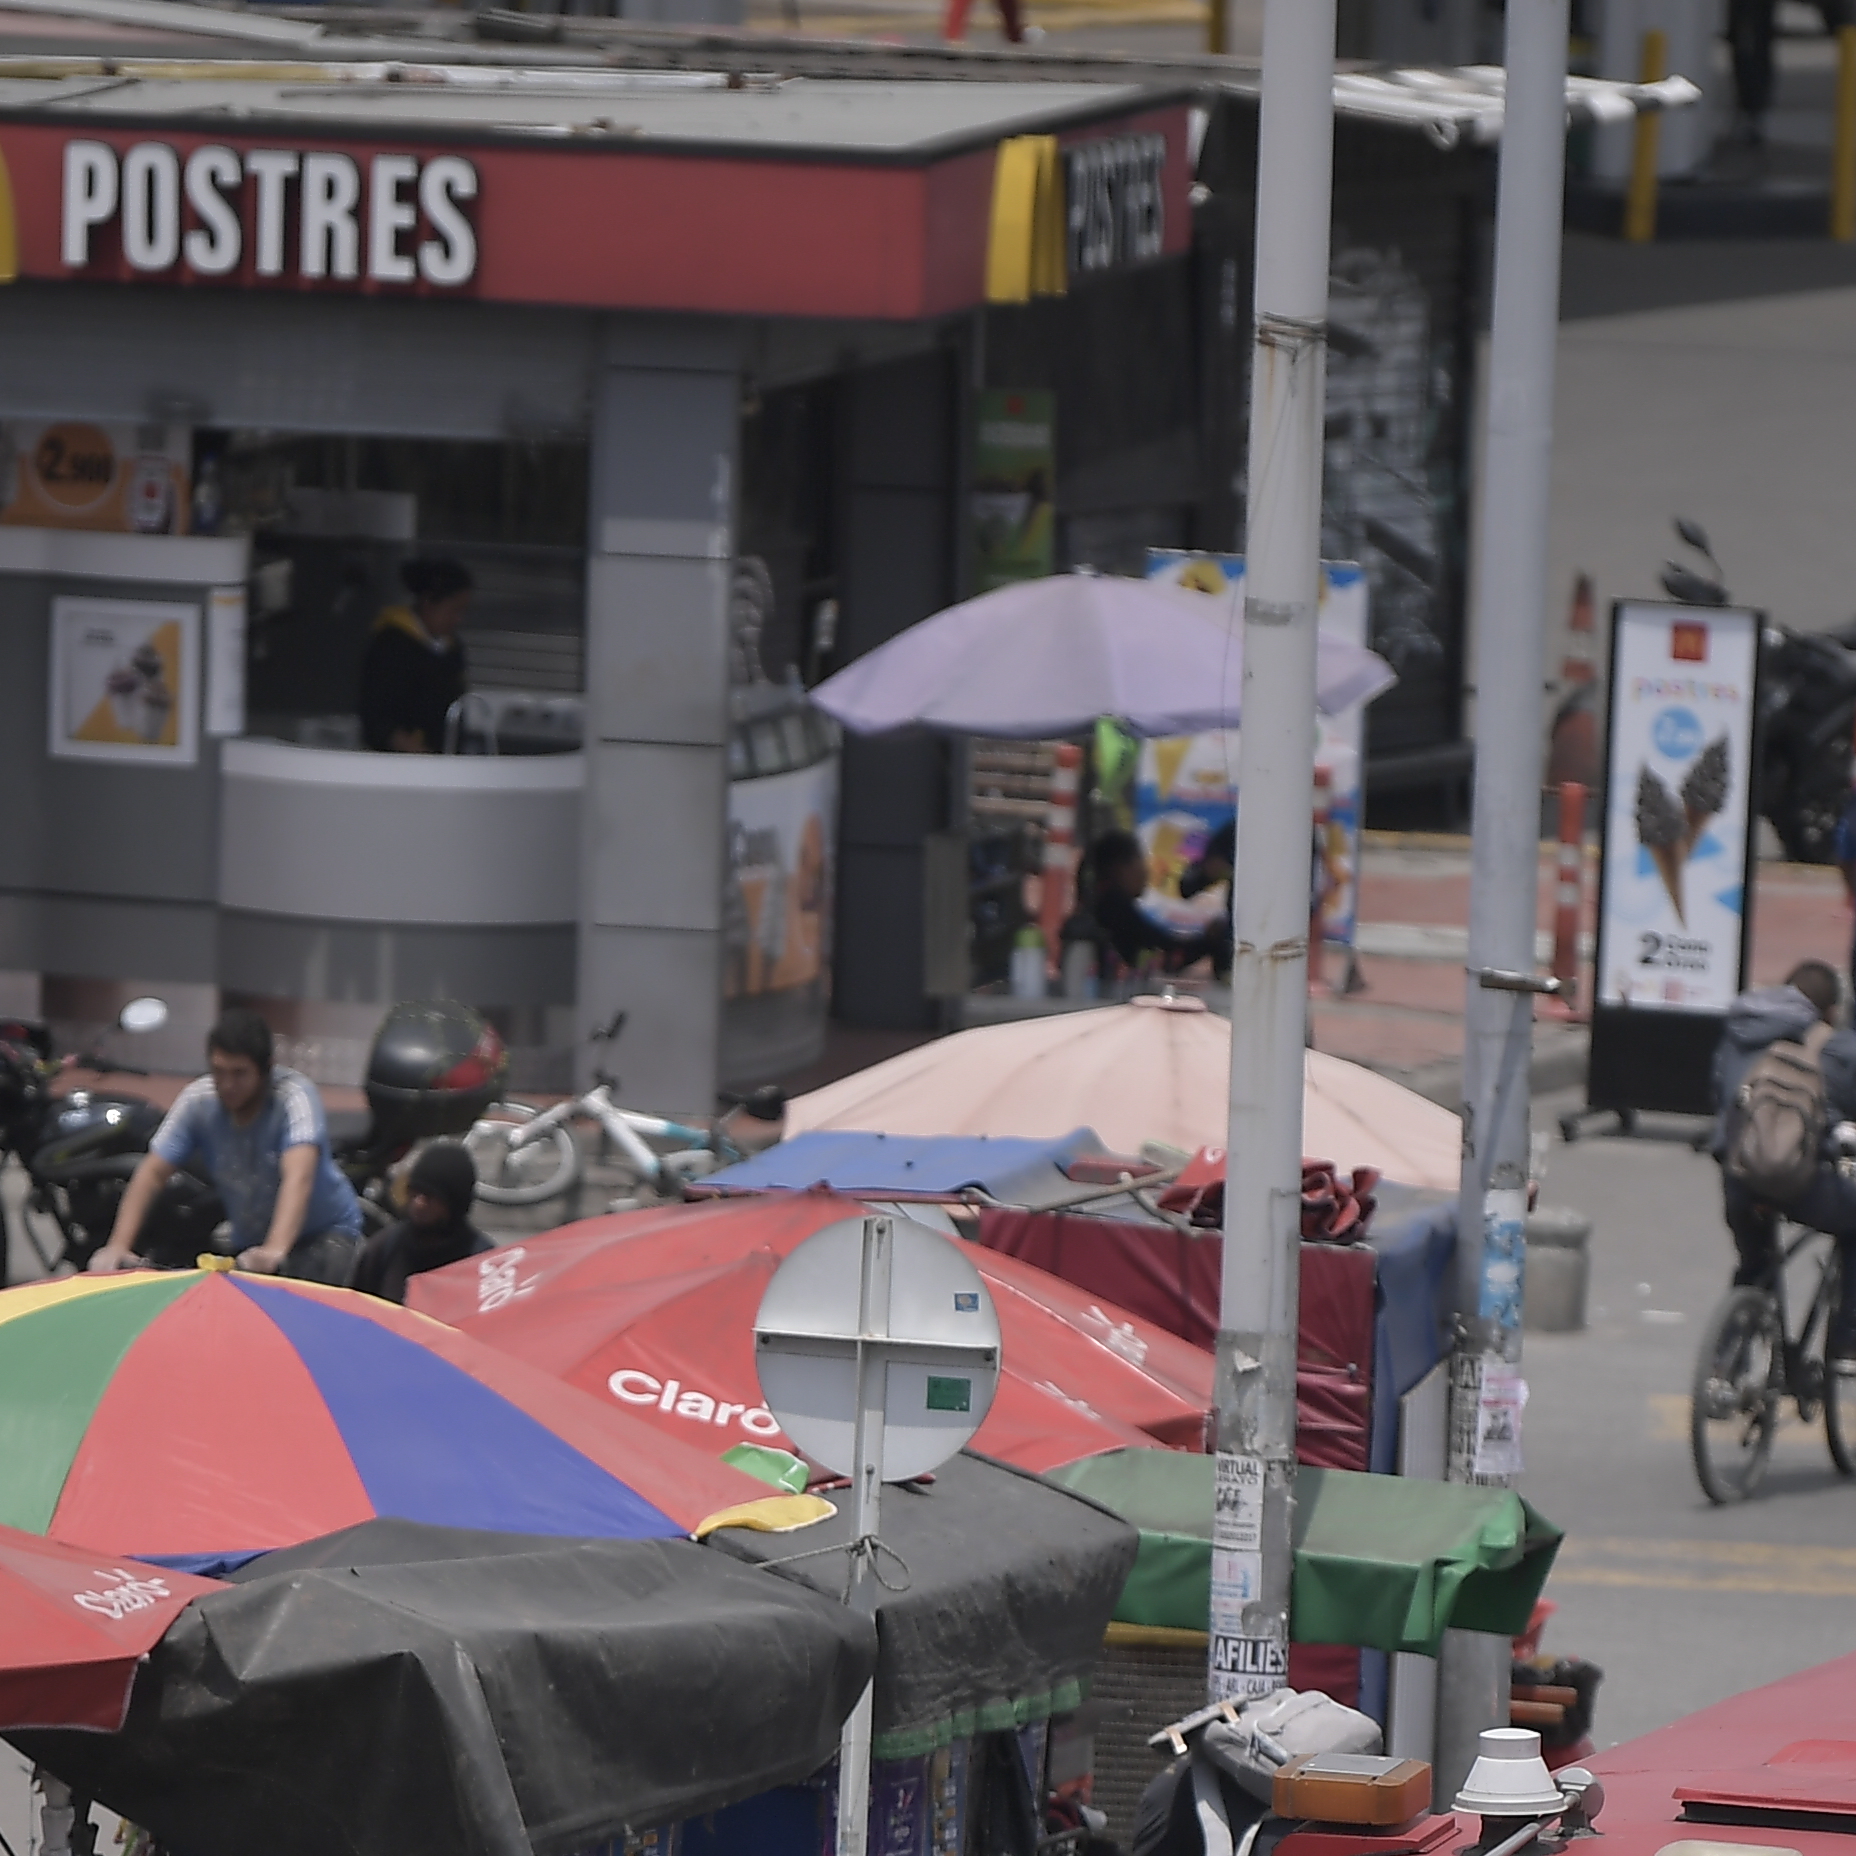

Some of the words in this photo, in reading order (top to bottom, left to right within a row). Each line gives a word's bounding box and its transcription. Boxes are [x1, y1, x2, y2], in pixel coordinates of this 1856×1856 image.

[61, 138, 478, 287] POSTRES
[607, 1369, 782, 1437] Claro
[73, 1575, 166, 1621] Claro
